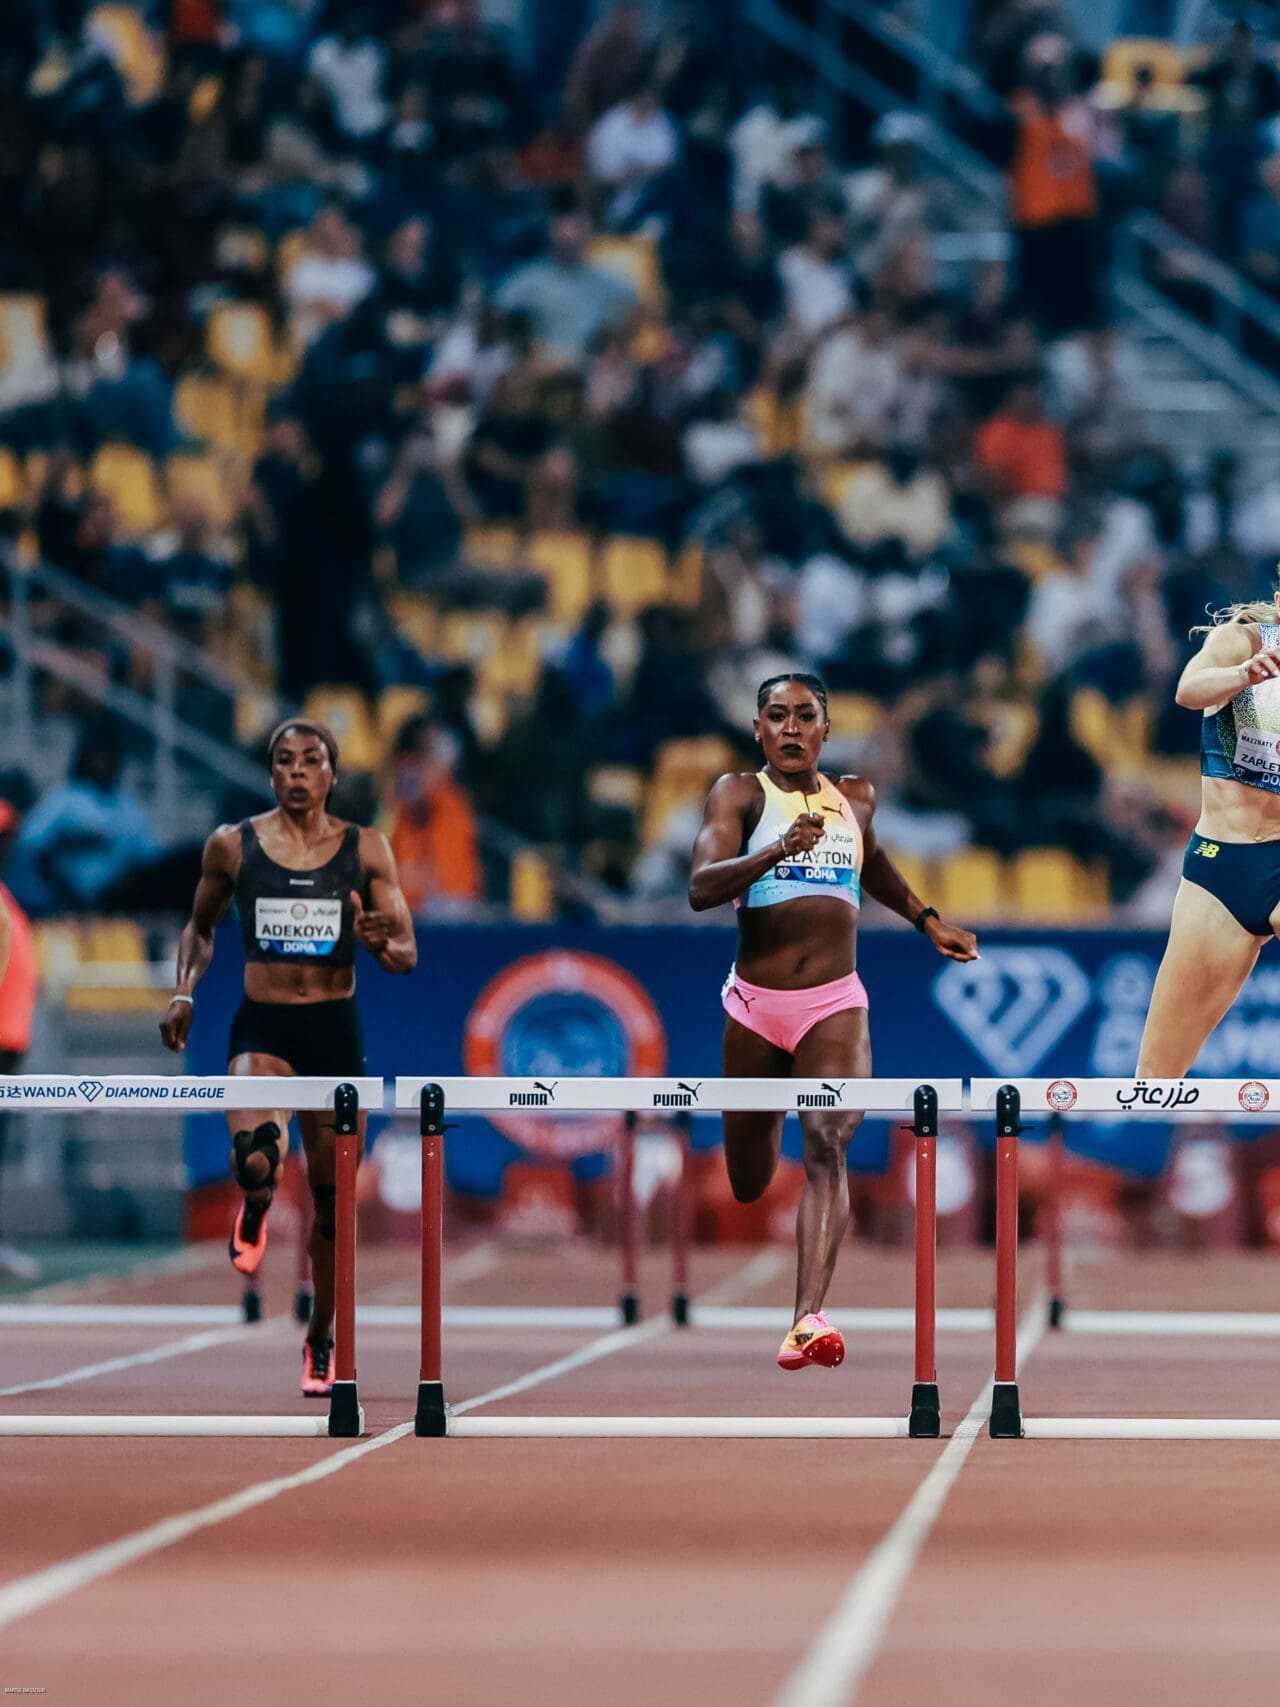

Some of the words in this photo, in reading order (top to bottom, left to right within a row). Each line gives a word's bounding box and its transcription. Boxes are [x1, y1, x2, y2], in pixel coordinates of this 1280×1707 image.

[805, 867, 838, 880] DOHA
[261, 923, 334, 938] ADEKOYA
[283, 941, 317, 953] DOHA
[23, 1086, 77, 1098] WANDA
[105, 1087, 169, 1098] DIAMOND
[172, 1087, 225, 1098] LEAGUE
[1116, 1081, 1200, 1110] مزرعتي
[509, 1093, 548, 1106] PUMA
[653, 1093, 692, 1106] PUMA
[797, 1094, 836, 1107] PUMA
